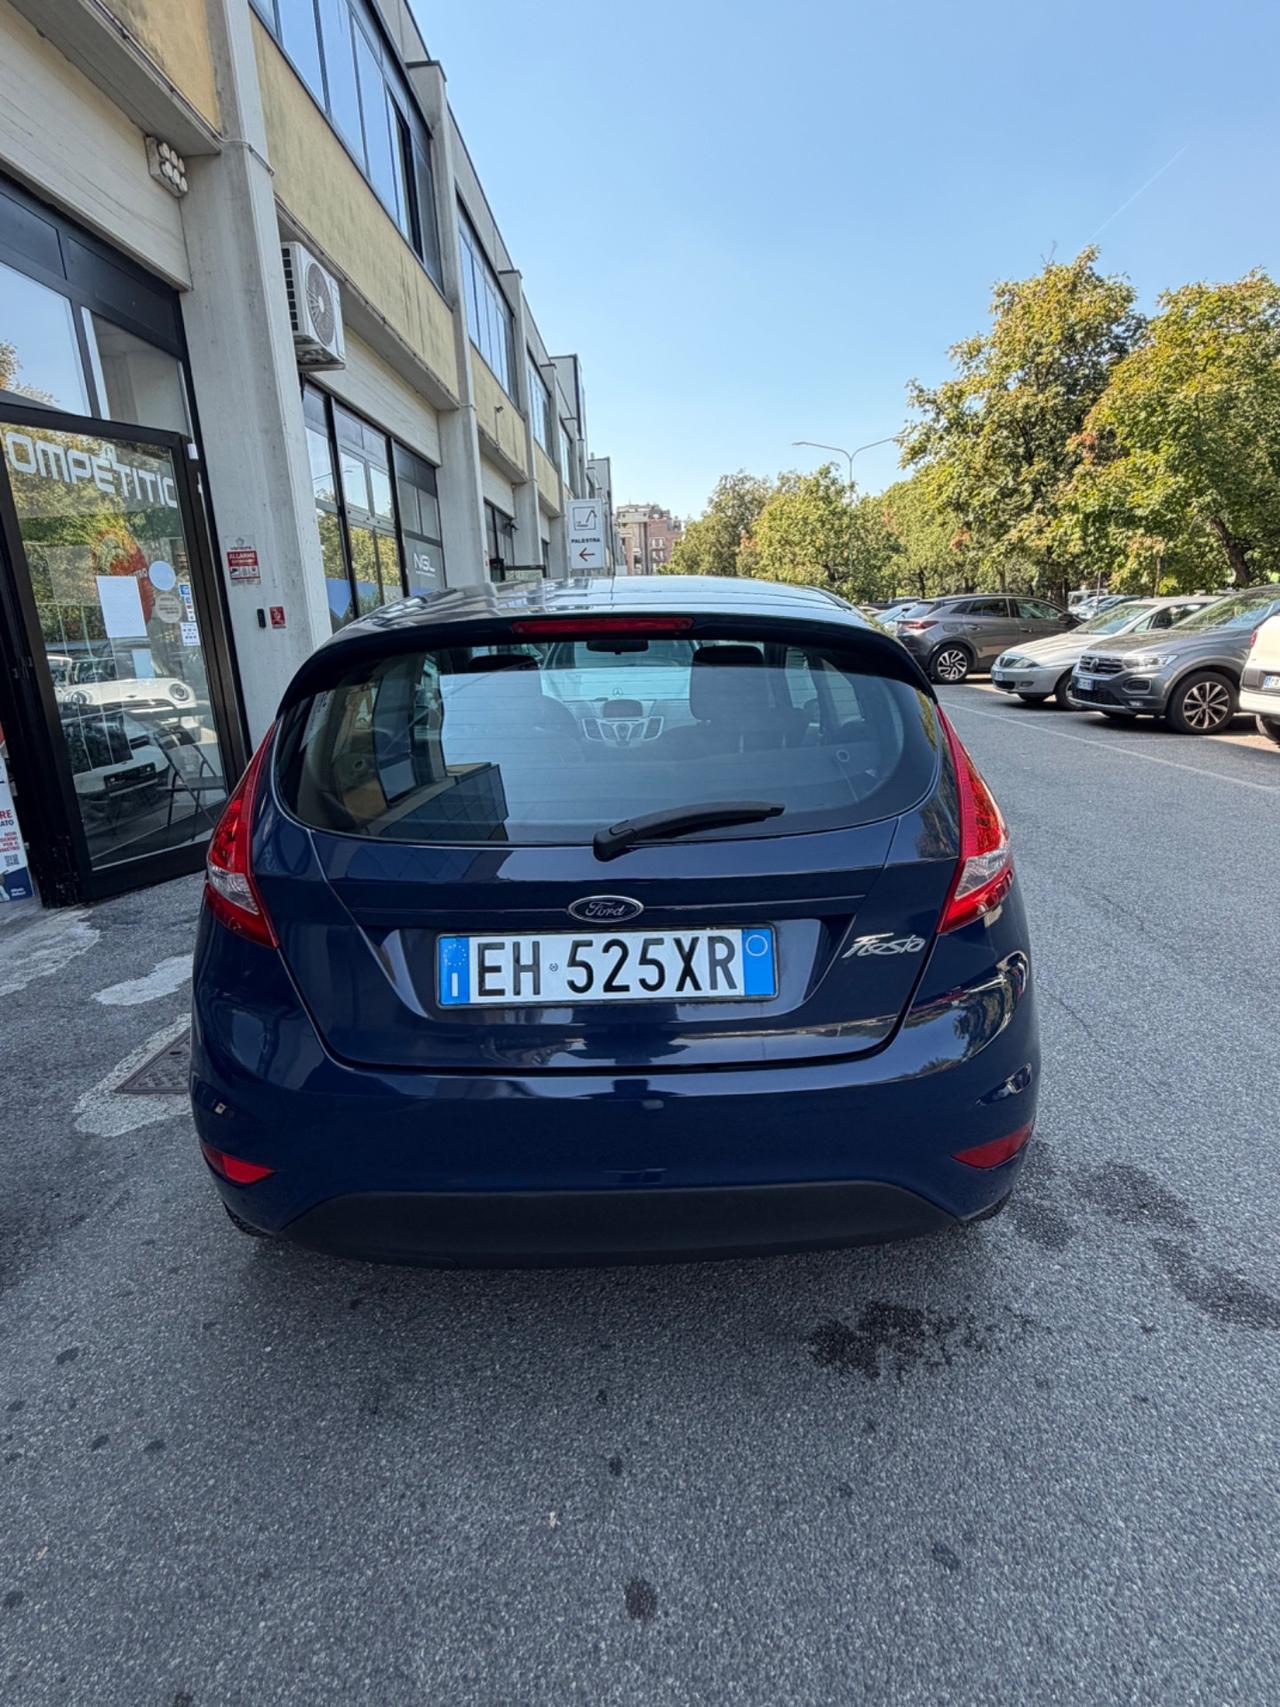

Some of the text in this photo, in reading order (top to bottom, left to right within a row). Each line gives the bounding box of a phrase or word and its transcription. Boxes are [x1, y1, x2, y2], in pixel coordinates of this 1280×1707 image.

[585, 901, 625, 916] Ford
[841, 932, 926, 958] Fiesta
[477, 935, 738, 997] EH 525XR
